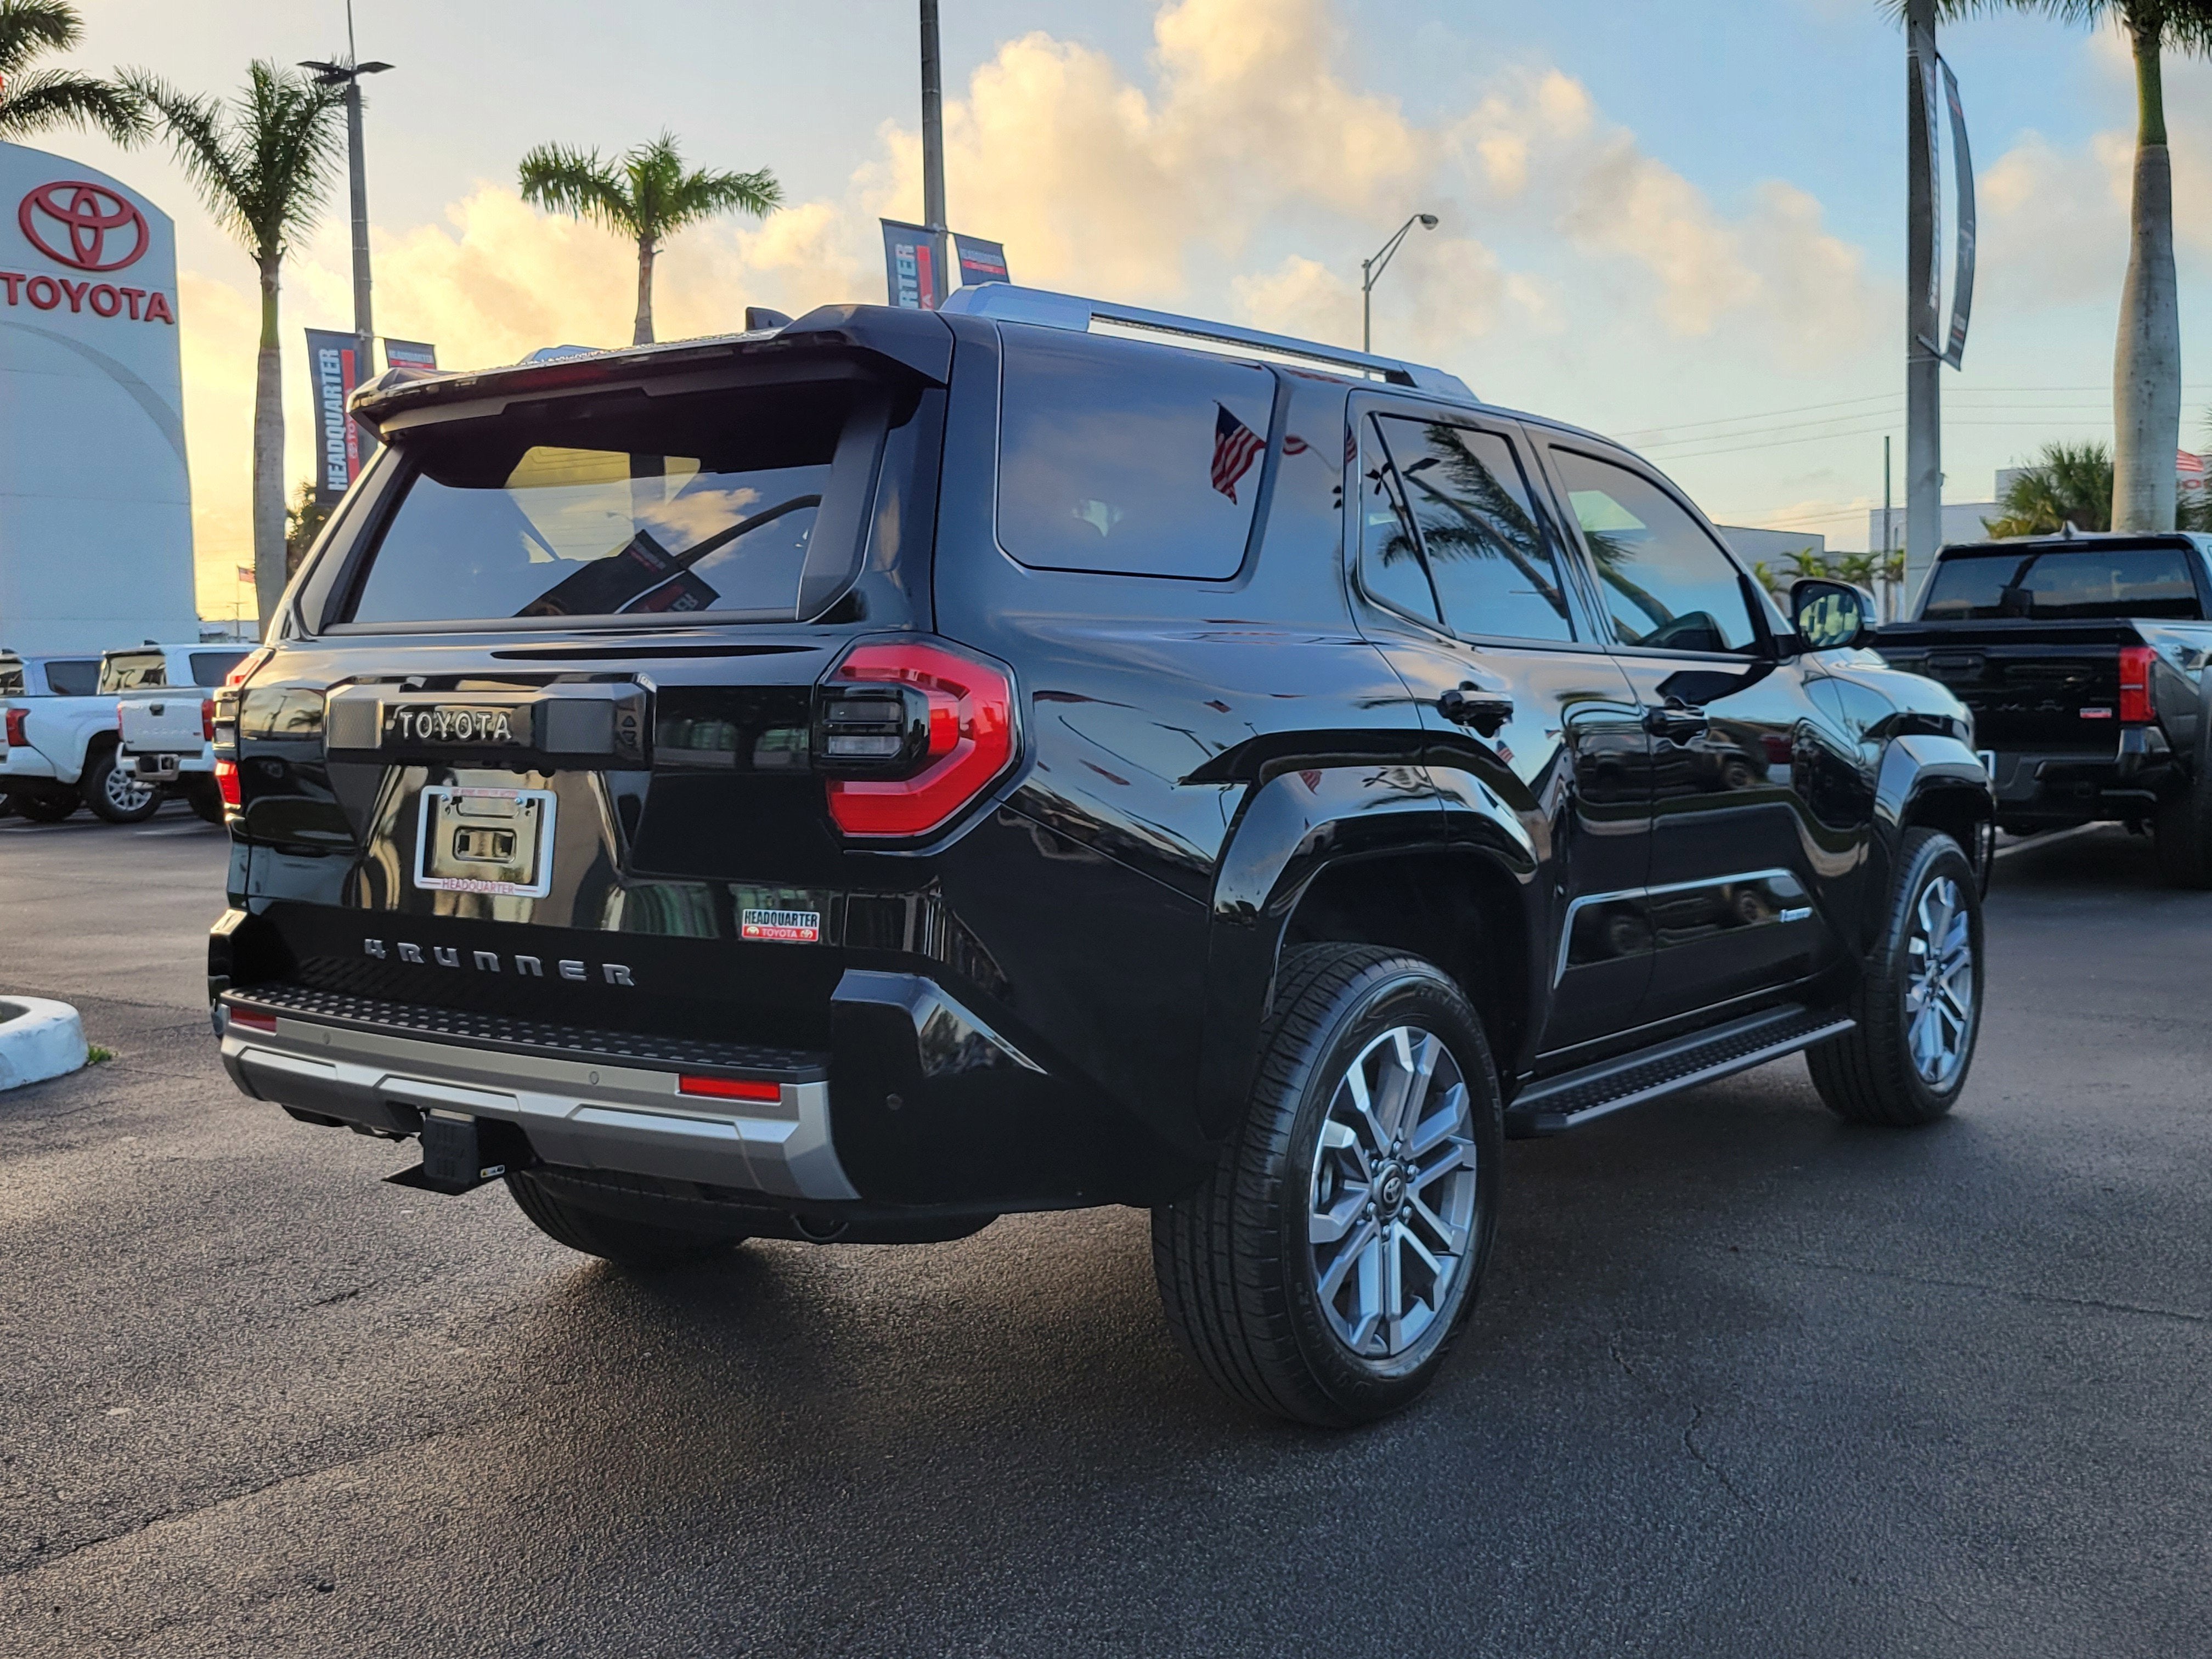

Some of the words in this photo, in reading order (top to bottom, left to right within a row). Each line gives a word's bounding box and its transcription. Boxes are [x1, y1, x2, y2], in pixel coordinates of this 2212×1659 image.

[1, 272, 174, 325] TOYOTA
[319, 348, 348, 491] HEADQUARTER
[400, 711, 512, 740] TOYOTA
[442, 878, 514, 894] HEADQUARTER
[744, 911, 817, 927] HEADQUARTER
[763, 928, 798, 938] TOYOTA
[364, 938, 635, 986] 4RUNNER
